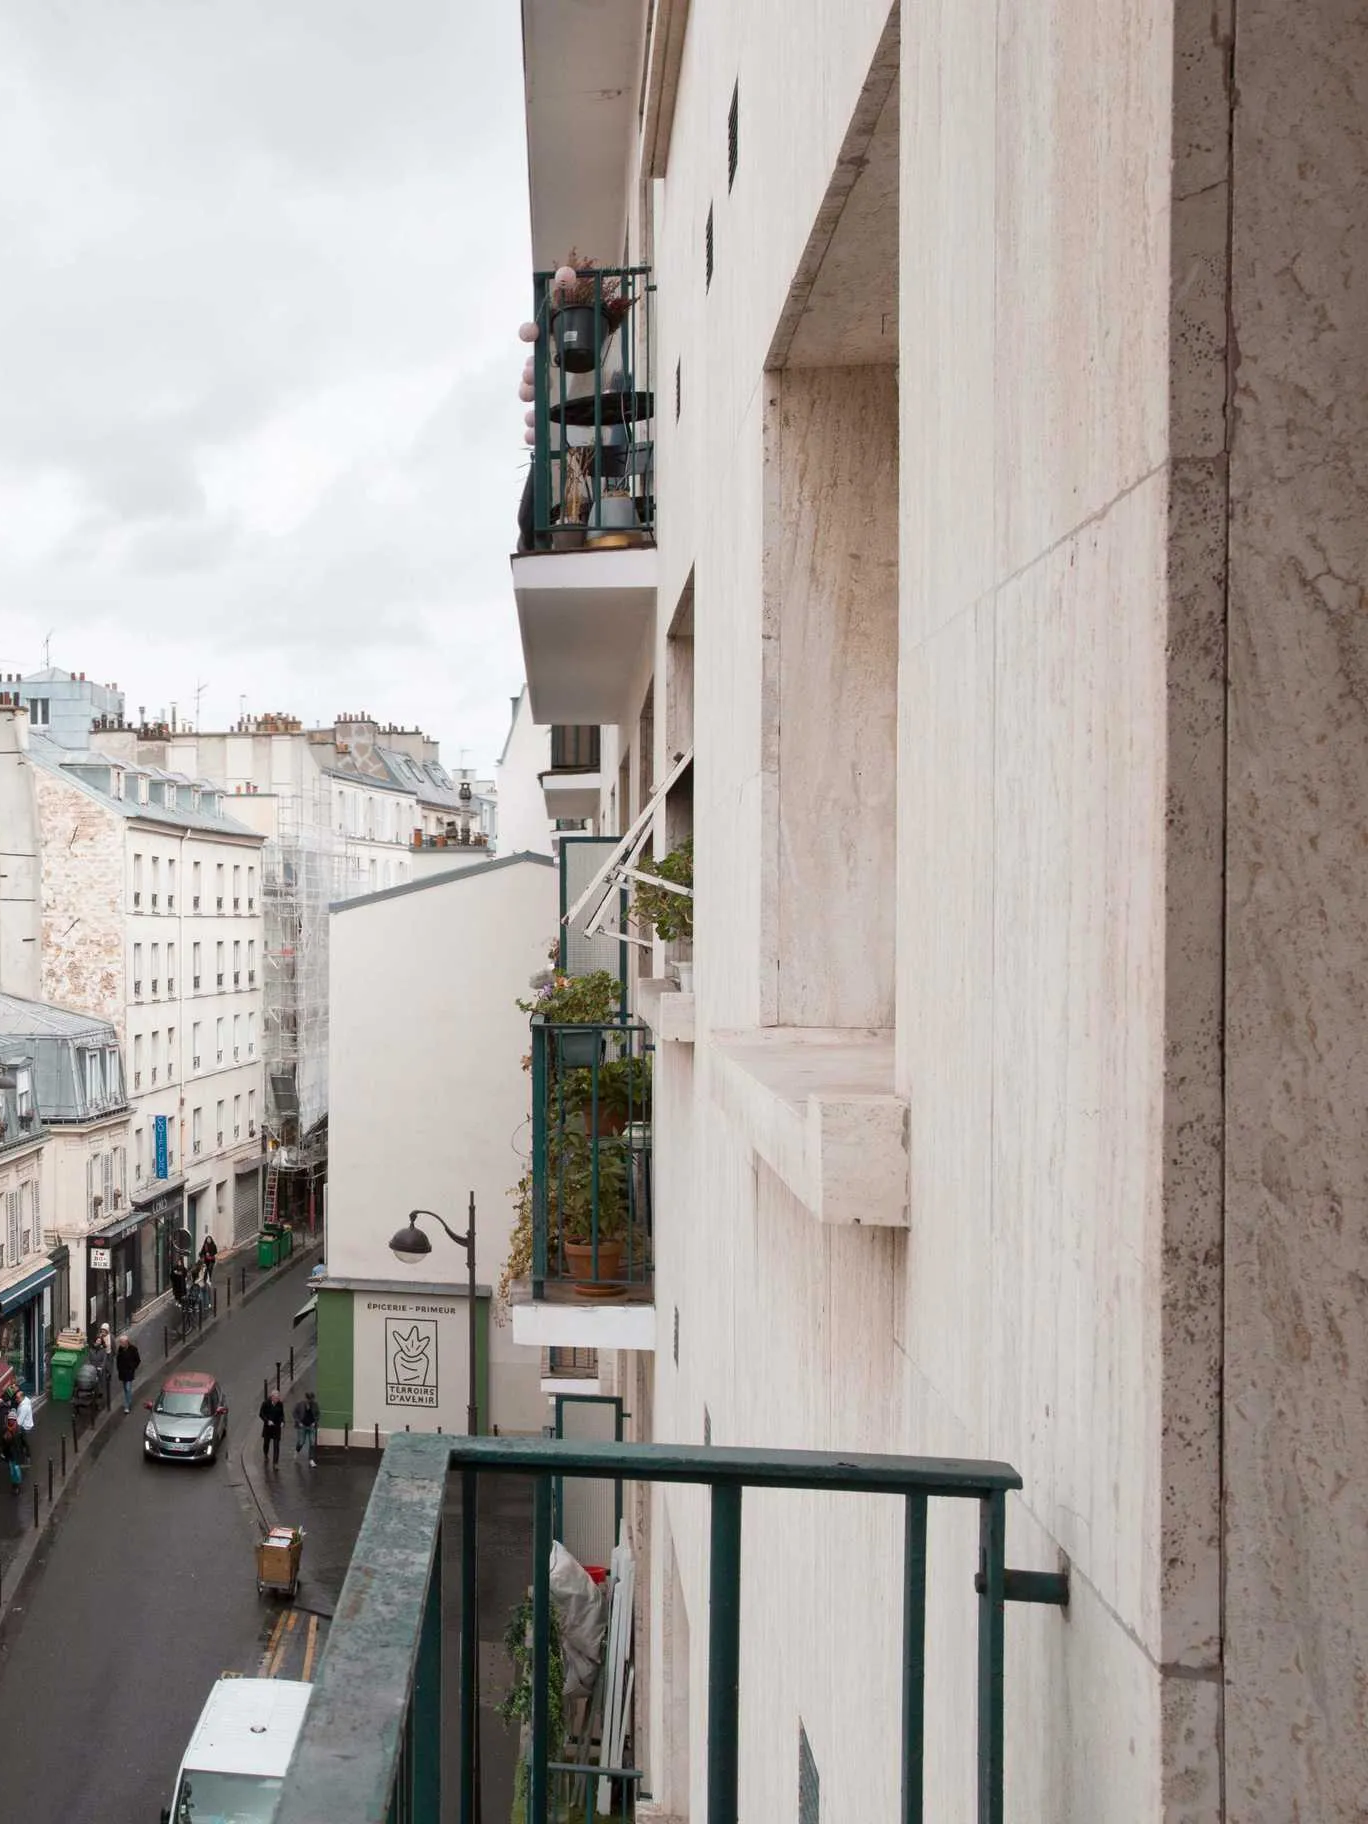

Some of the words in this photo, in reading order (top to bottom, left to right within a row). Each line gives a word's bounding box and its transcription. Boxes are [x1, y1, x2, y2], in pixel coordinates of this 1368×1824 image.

[367, 1302, 407, 1312] ÉPICERIE
[415, 1305, 456, 1314] PRIMEUR
[389, 1385, 435, 1396] TERROIRS
[389, 1394, 435, 1404] D'AVENIR
